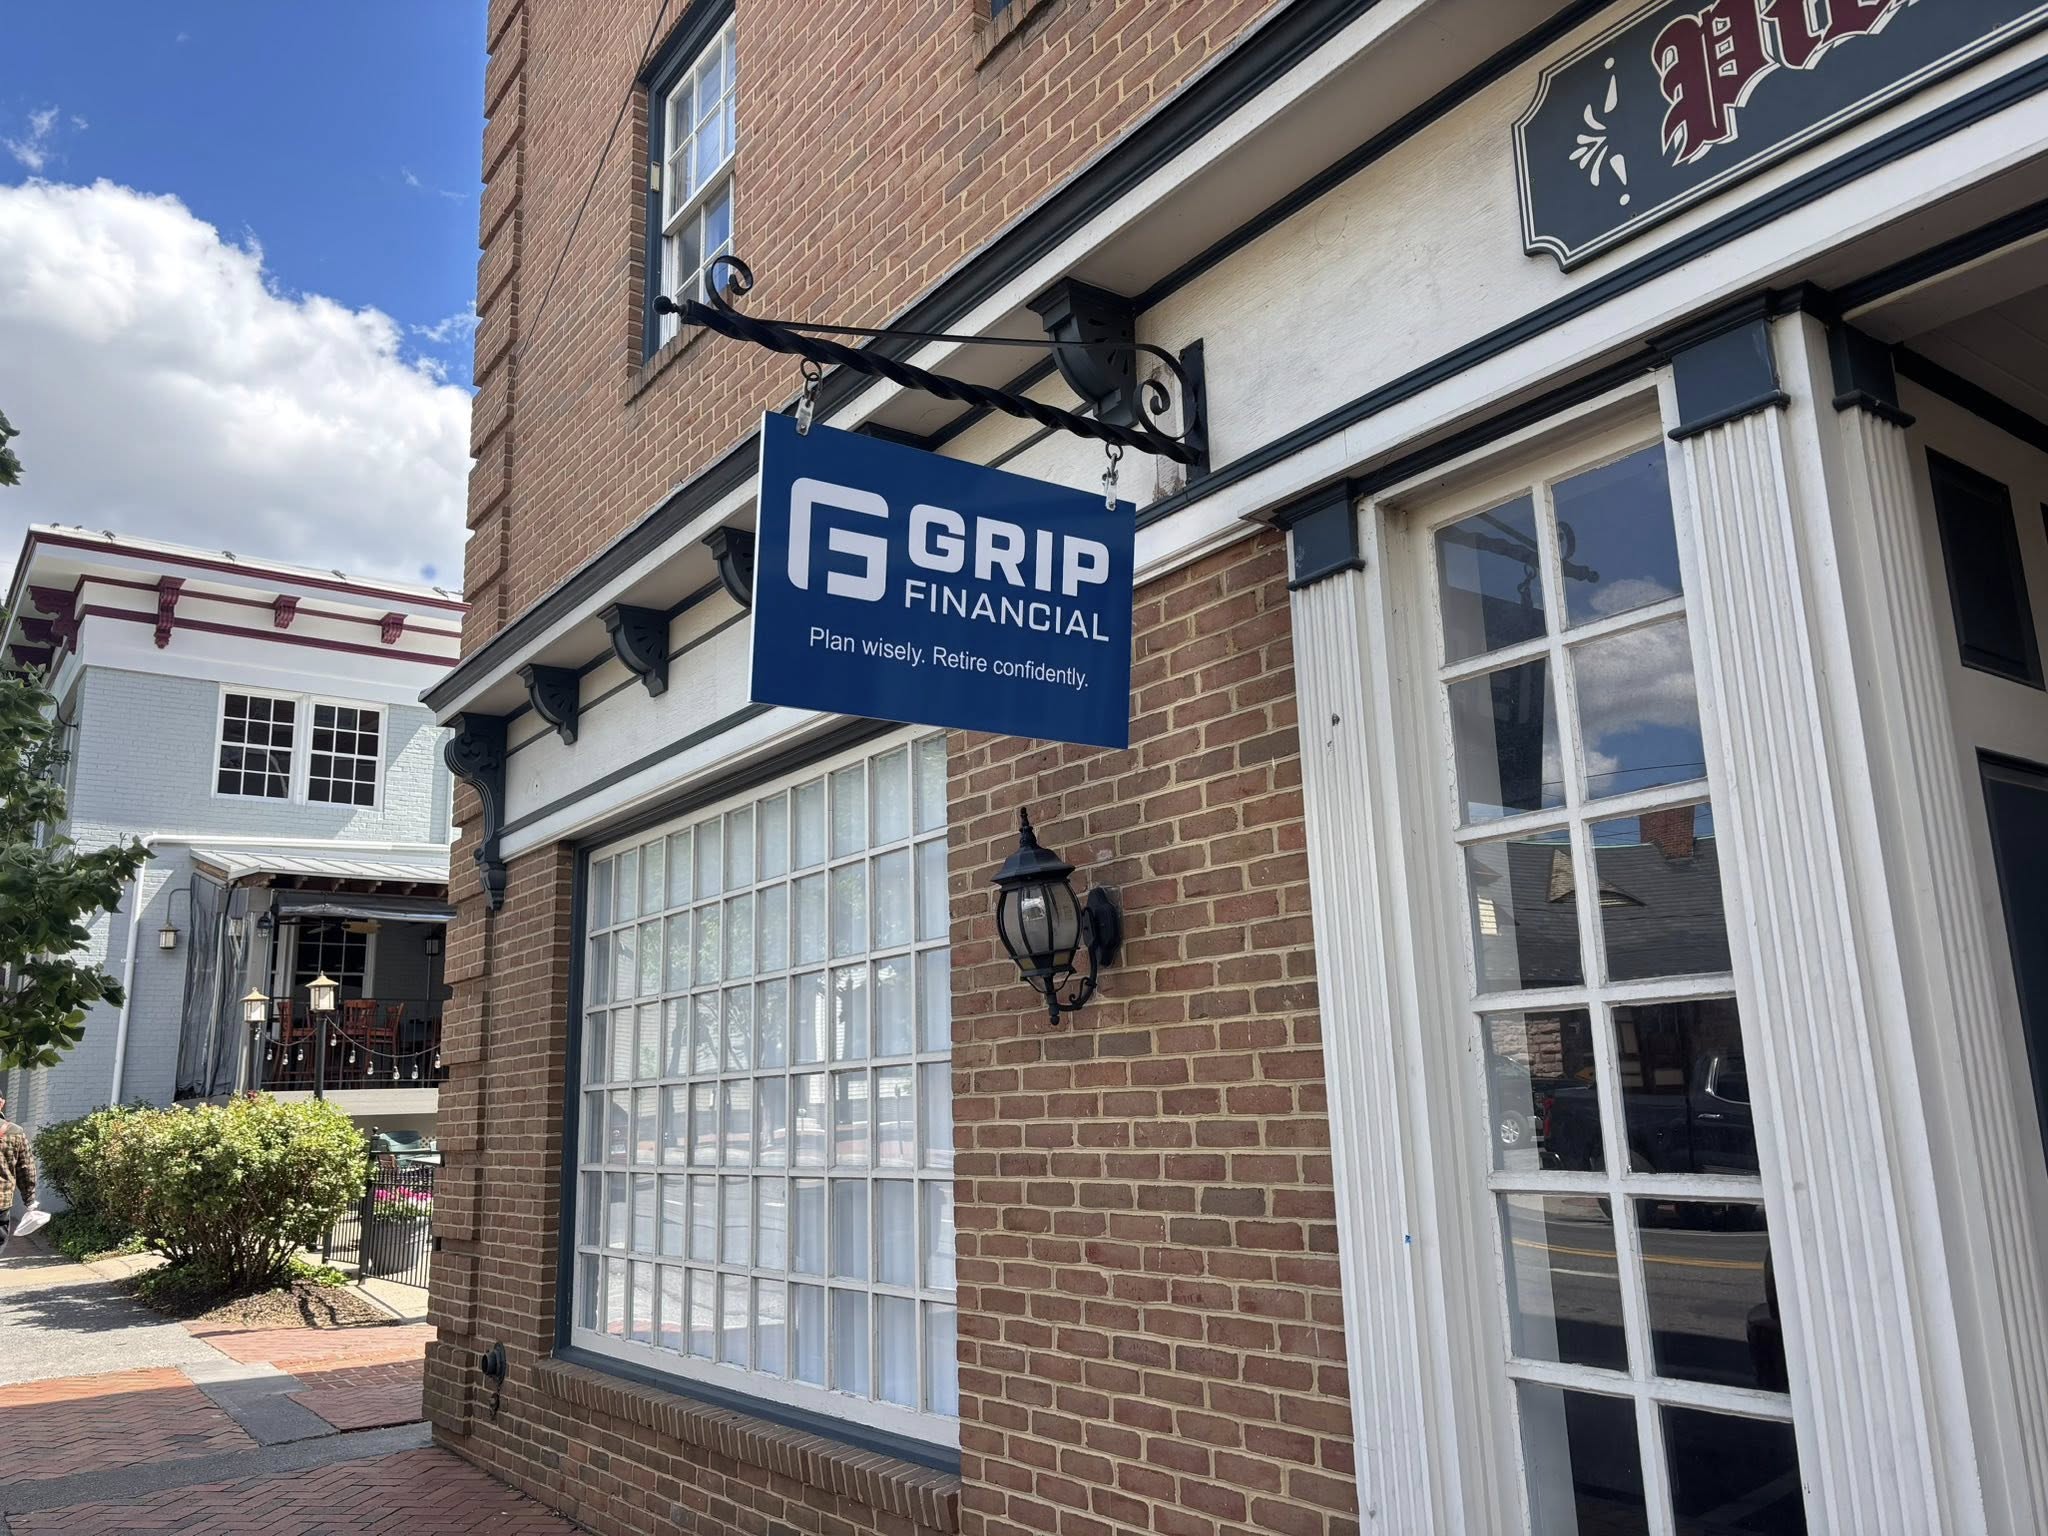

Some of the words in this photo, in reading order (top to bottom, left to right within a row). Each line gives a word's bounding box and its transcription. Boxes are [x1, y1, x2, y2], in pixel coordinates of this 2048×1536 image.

[908, 503, 1110, 597] GRIP
[904, 578, 1110, 642] FINANCIAL
[809, 626, 855, 653] Plan
[861, 639, 926, 667] wisely.
[932, 645, 988, 673] Retire
[992, 660, 1089, 691] confidently.
